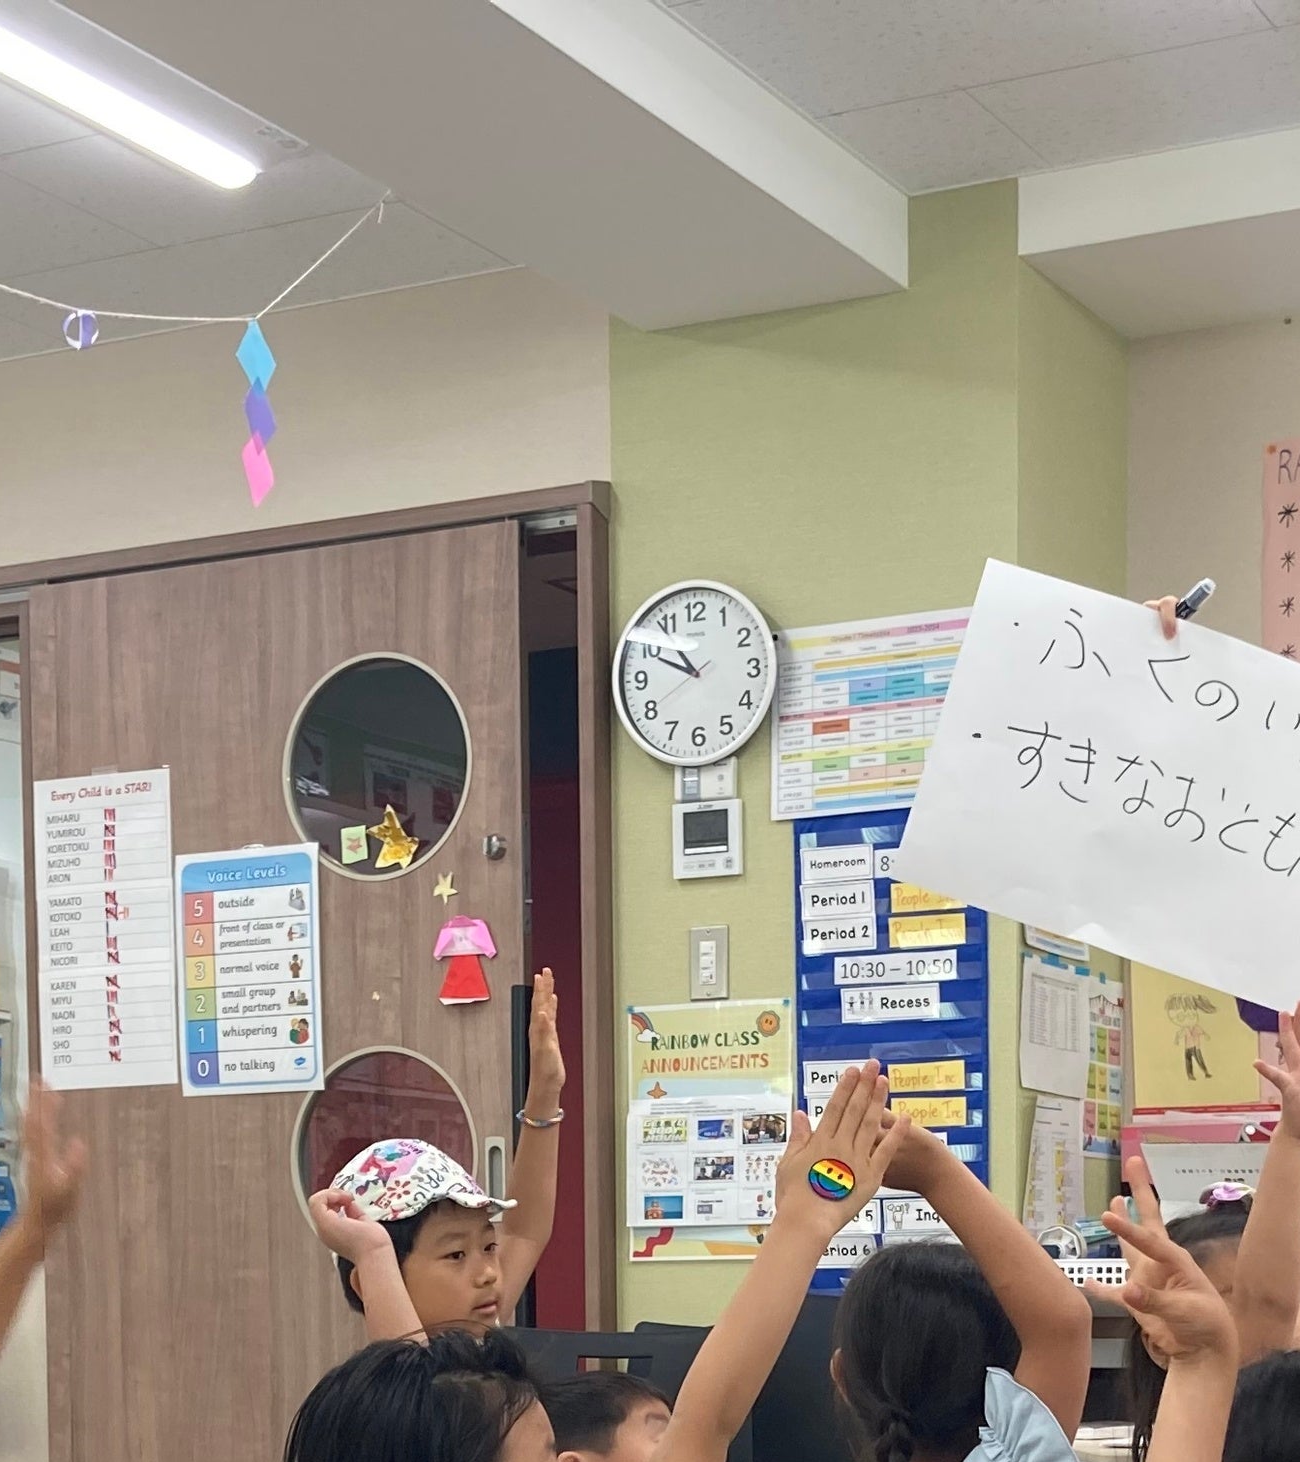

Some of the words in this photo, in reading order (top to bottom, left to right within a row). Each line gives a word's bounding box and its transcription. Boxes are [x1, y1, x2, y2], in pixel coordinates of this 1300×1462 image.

[684, 602, 706, 622] 12
[718, 606, 727, 627] 1
[738, 628, 751, 648] 2
[746, 658, 760, 678] 3
[634, 670, 648, 690] 9
[645, 700, 658, 720] 8
[739, 690, 752, 710] 4
[665, 721, 679, 741] 7
[720, 715, 733, 735] 5
[692, 726, 706, 746] 6
[51, 791, 75, 803] Every
[78, 786, 101, 798] Child
[105, 787, 112, 795] is
[124, 782, 152, 794] STAR!
[810, 858, 866, 869] Homeroom
[208, 869, 242, 883] Voice
[246, 866, 287, 880] Levels
[194, 900, 203, 917] 5
[218, 896, 255, 909] outside
[811, 894, 856, 907] Period
[193, 930, 204, 947] 4
[811, 927, 855, 940] Period
[862, 926, 870, 938] 2
[195, 962, 205, 981] 3
[220, 961, 252, 974] normal
[256, 961, 279, 971] voice
[841, 962, 885, 979] 10:30
[906, 958, 953, 976] 10:50
[196, 995, 206, 1013] 2
[221, 988, 247, 999] small
[249, 987, 276, 1000] group
[222, 1003, 240, 1014] and
[242, 1002, 281, 1016] partners
[880, 997, 930, 1009] Recess
[198, 1026, 205, 1044] 1
[222, 1024, 277, 1038] whispering
[651, 1034, 710, 1051] RAINBOW
[715, 1031, 760, 1046] CLASS
[197, 1060, 209, 1077] 0
[224, 1062, 237, 1072] no
[240, 1060, 275, 1073] talking
[642, 1053, 769, 1074] ANNOUNCEMENTS
[811, 1071, 842, 1084] Peri
[893, 1067, 930, 1088] People
[822, 1245, 858, 1256] eriod
[863, 1246, 871, 1255] 6
